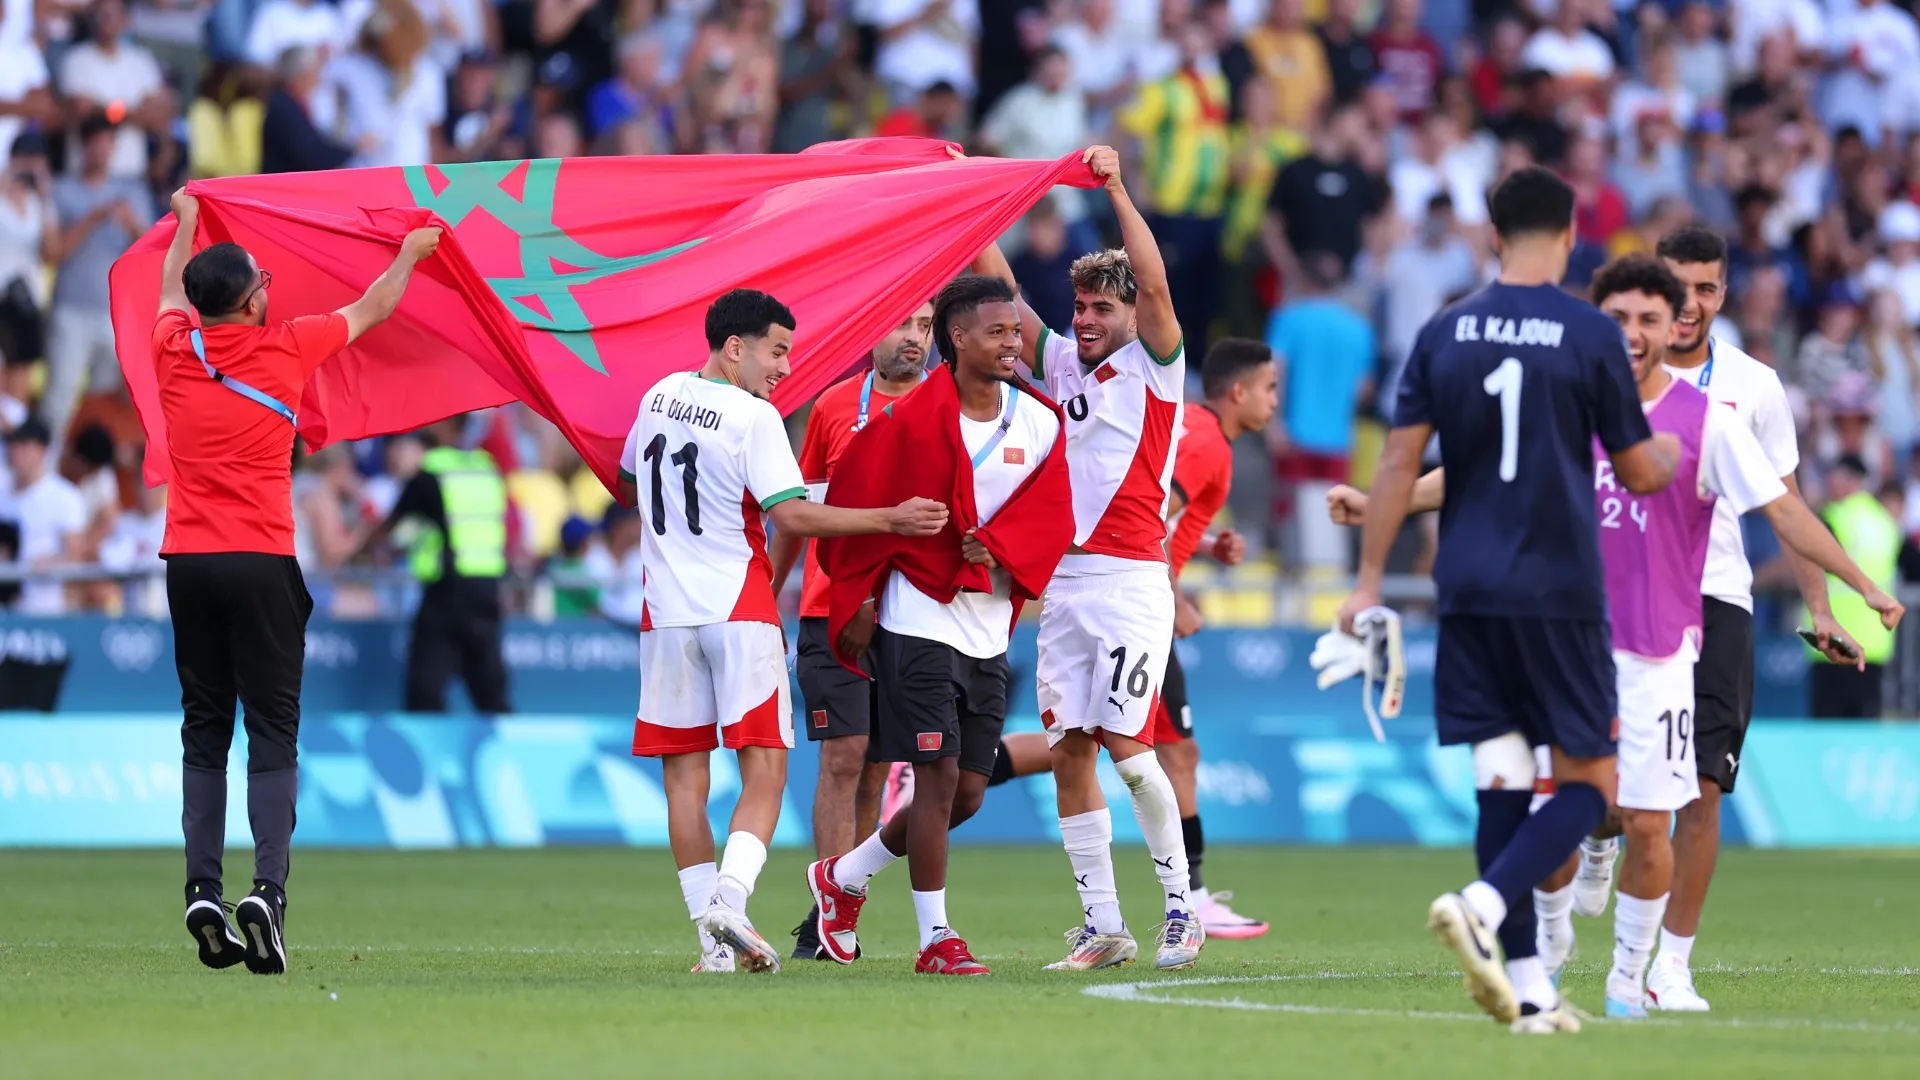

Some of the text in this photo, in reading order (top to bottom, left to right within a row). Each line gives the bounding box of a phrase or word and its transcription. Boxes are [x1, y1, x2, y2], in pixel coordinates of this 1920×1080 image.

[1455, 315, 1564, 348] EL KAJOUI
[651, 393, 723, 431] EL OUAHDI
[1483, 357, 1523, 482] 1
[644, 433, 703, 536] 11
[1110, 646, 1149, 698] 16
[1658, 708, 1690, 761] 19
